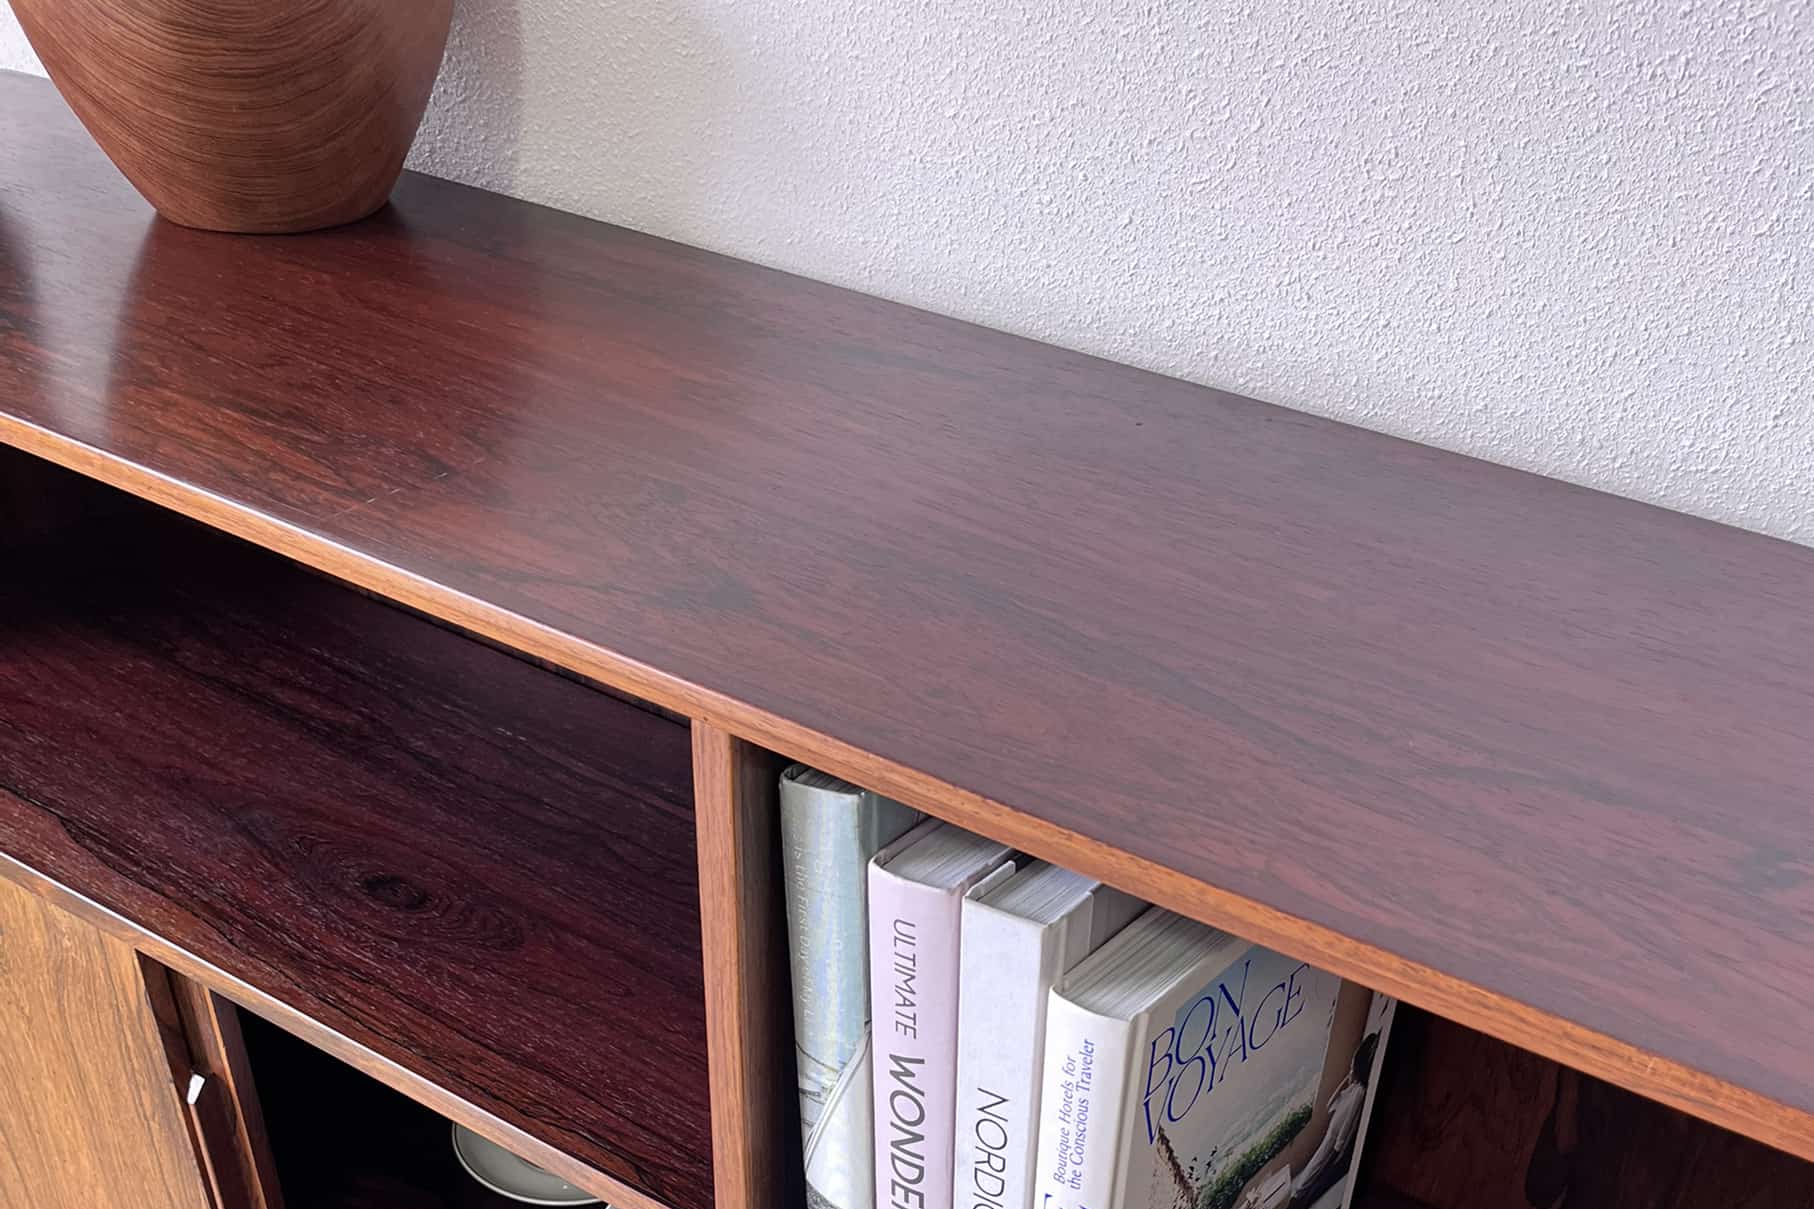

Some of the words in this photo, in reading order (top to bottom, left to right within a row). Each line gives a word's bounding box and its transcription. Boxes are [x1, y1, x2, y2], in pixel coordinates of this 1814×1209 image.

[893, 918, 917, 1040] ULTIMATE
[1143, 959, 1252, 1102] BON
[1143, 962, 1311, 1145] VOYAGE
[1062, 1055, 1077, 1077] for
[1075, 1038, 1095, 1092] Traveler
[1058, 1079, 1074, 1124] Hotels
[1053, 1127, 1071, 1185] Boutique
[1068, 1097, 1089, 1166] Conscious
[1067, 1169, 1082, 1190] the
